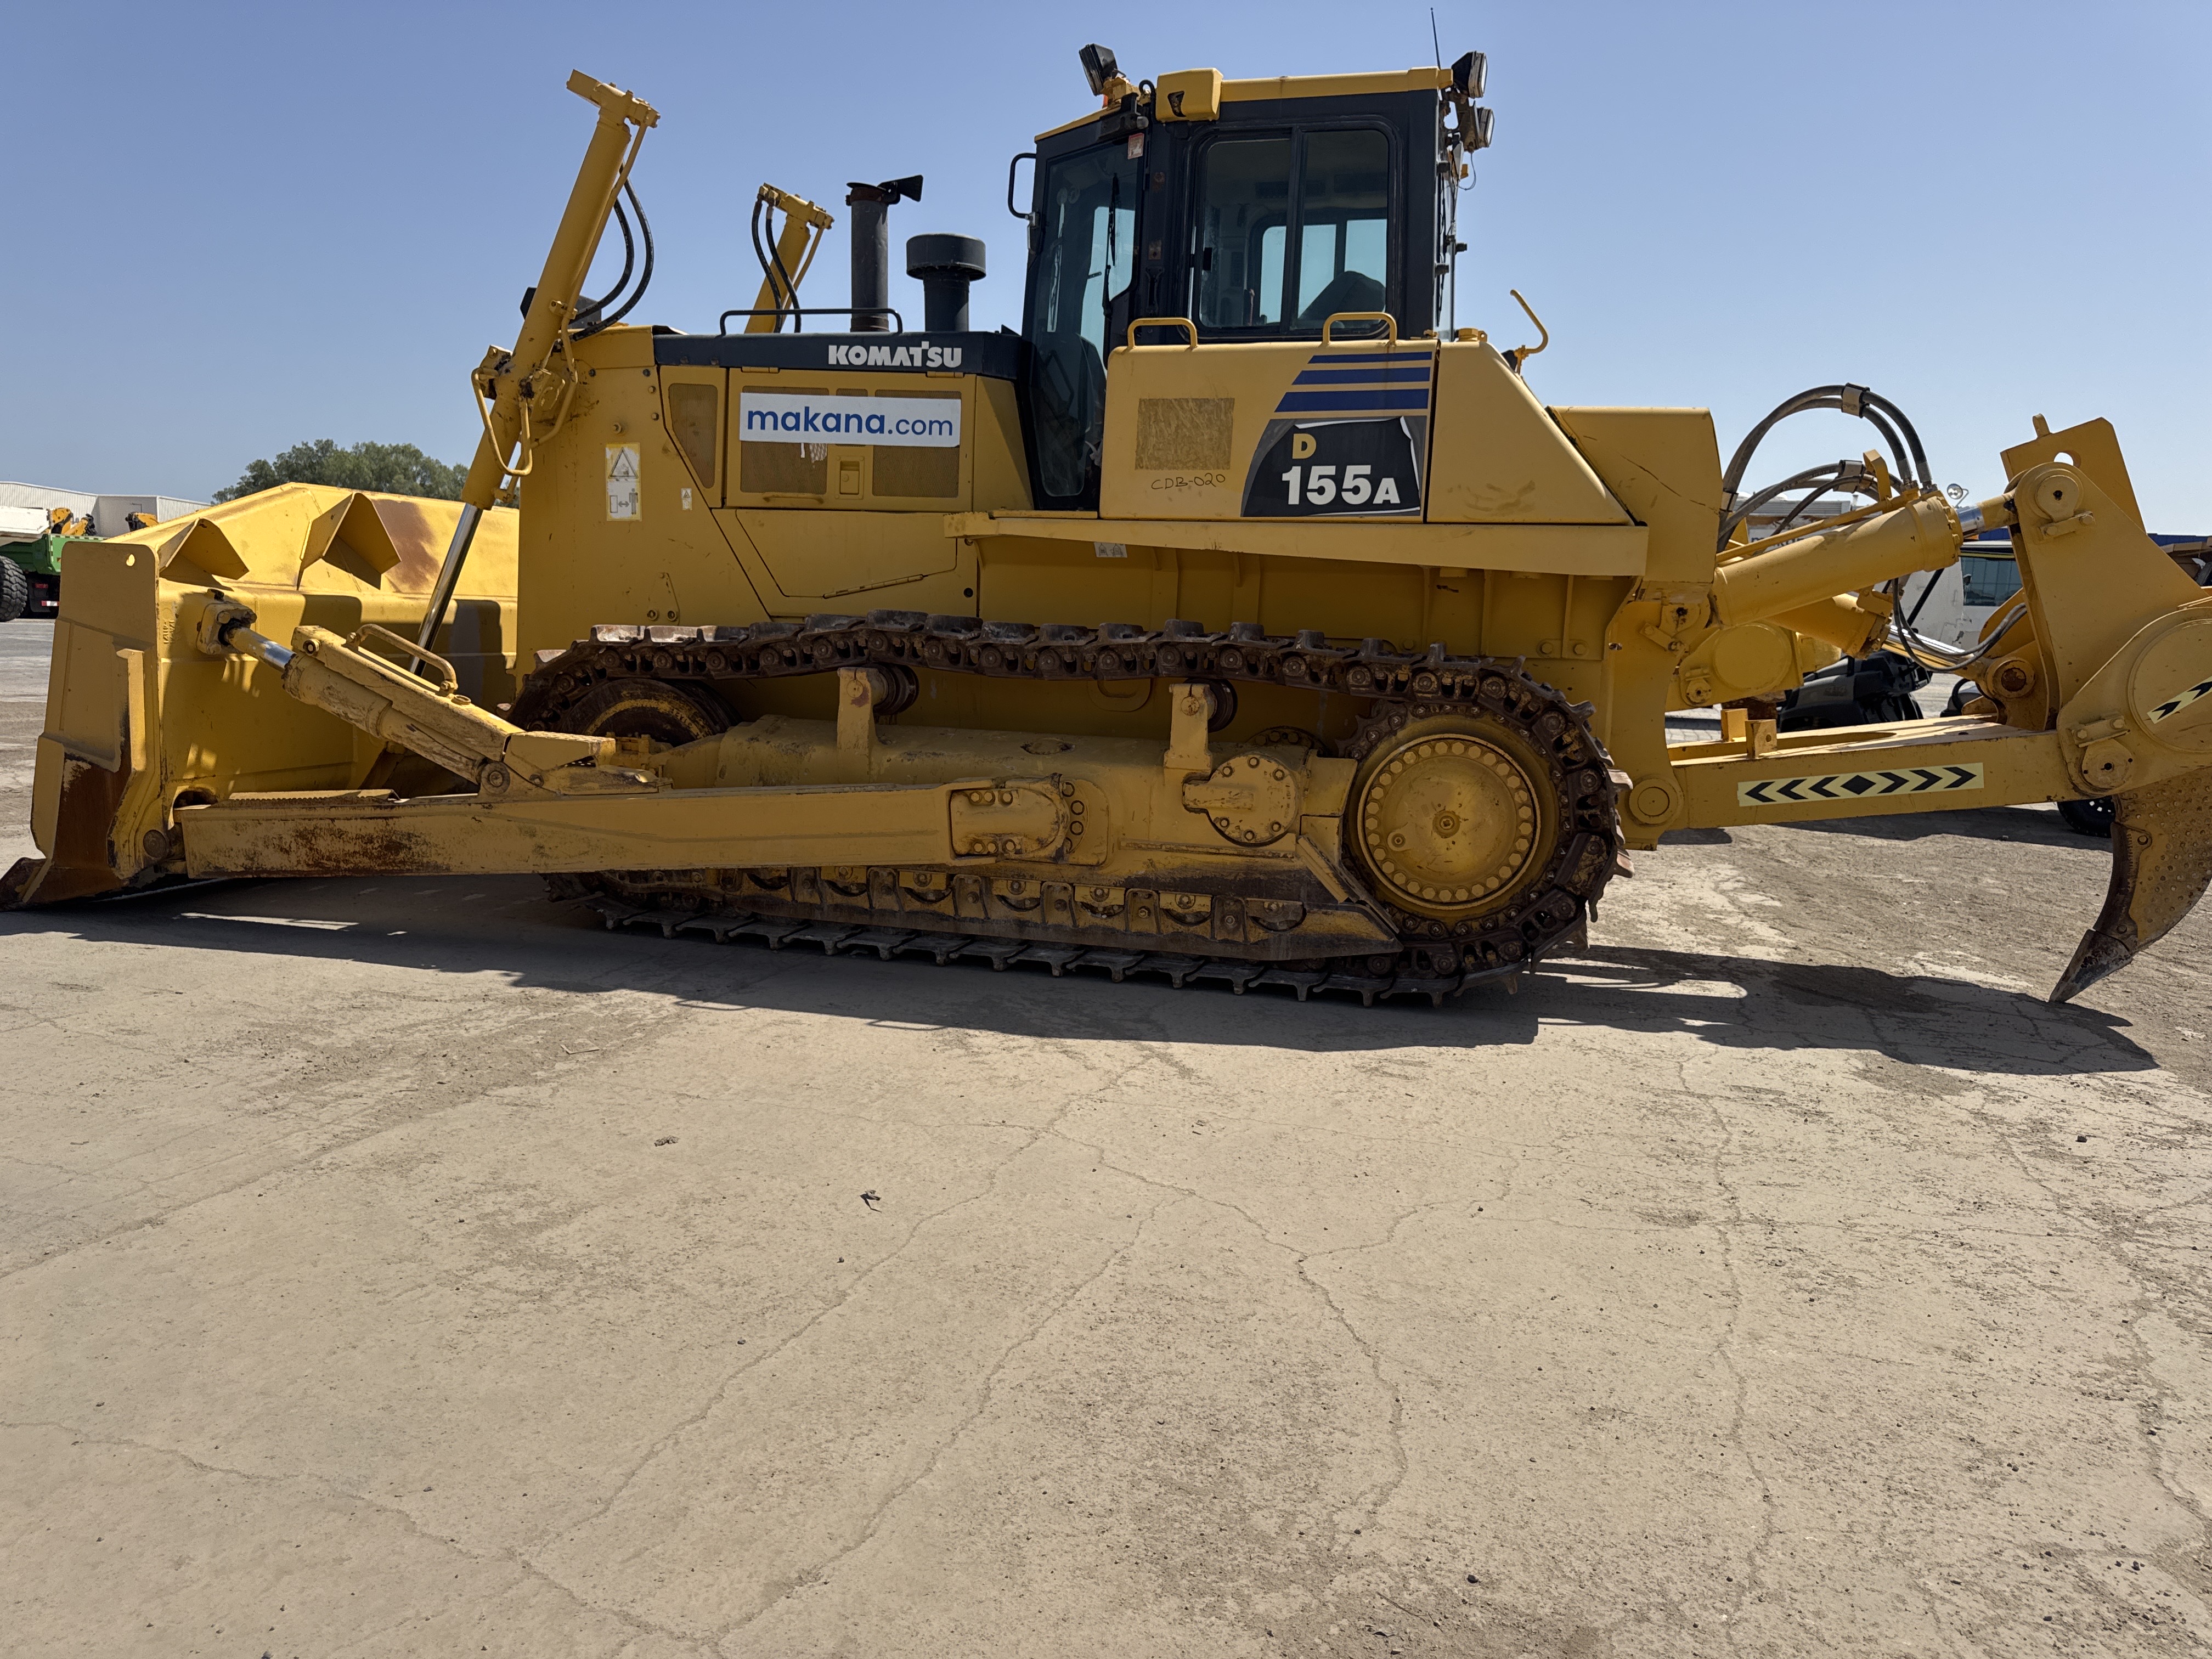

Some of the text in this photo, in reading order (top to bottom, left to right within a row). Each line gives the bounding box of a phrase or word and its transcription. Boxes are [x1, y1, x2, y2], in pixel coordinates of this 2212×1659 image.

[828, 341, 962, 368] KOMATSU
[747, 406, 953, 436] makana.com
[1292, 433, 1317, 460] D
[1151, 473, 1226, 491] CDB-020
[1282, 465, 1401, 505] 155A
